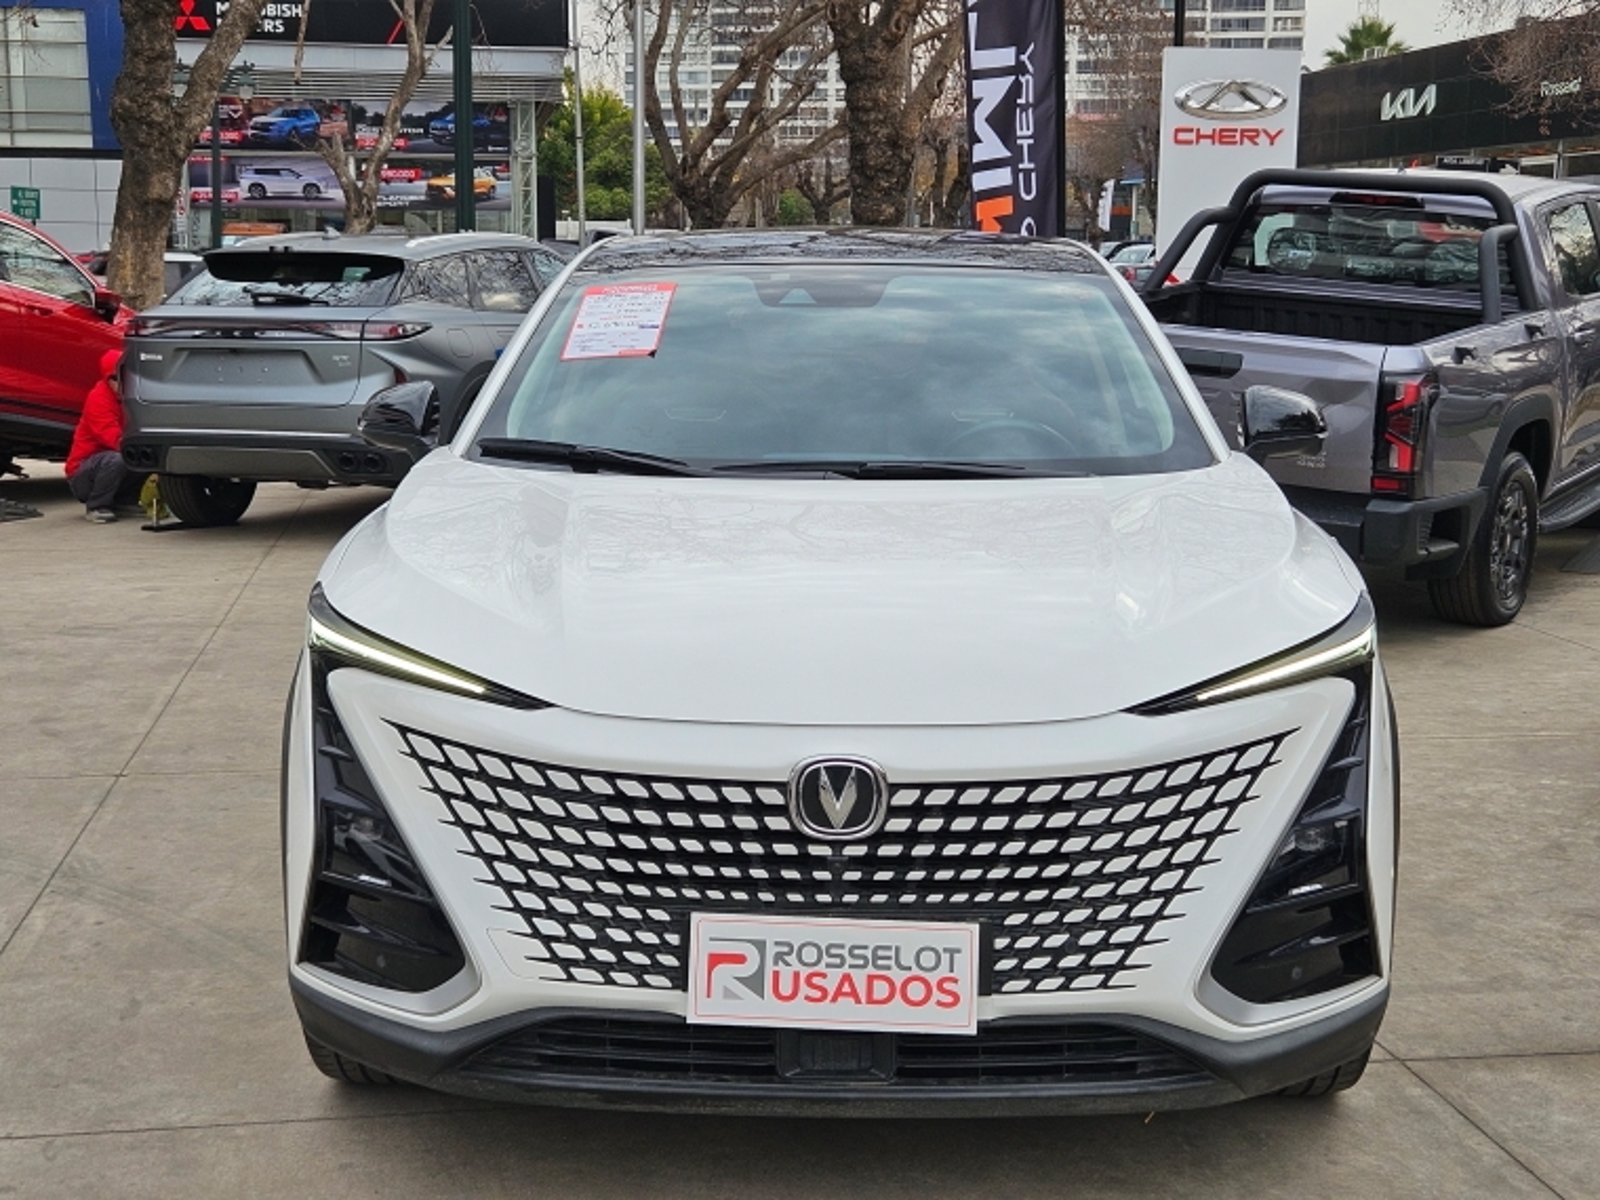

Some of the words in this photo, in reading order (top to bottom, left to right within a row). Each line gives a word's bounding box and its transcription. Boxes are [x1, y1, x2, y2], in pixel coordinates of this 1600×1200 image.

[1381, 84, 1437, 121] KIA
[1173, 127, 1284, 146] CHERY
[772, 940, 962, 973] ROSSELOT
[772, 970, 961, 1009] USADOS
